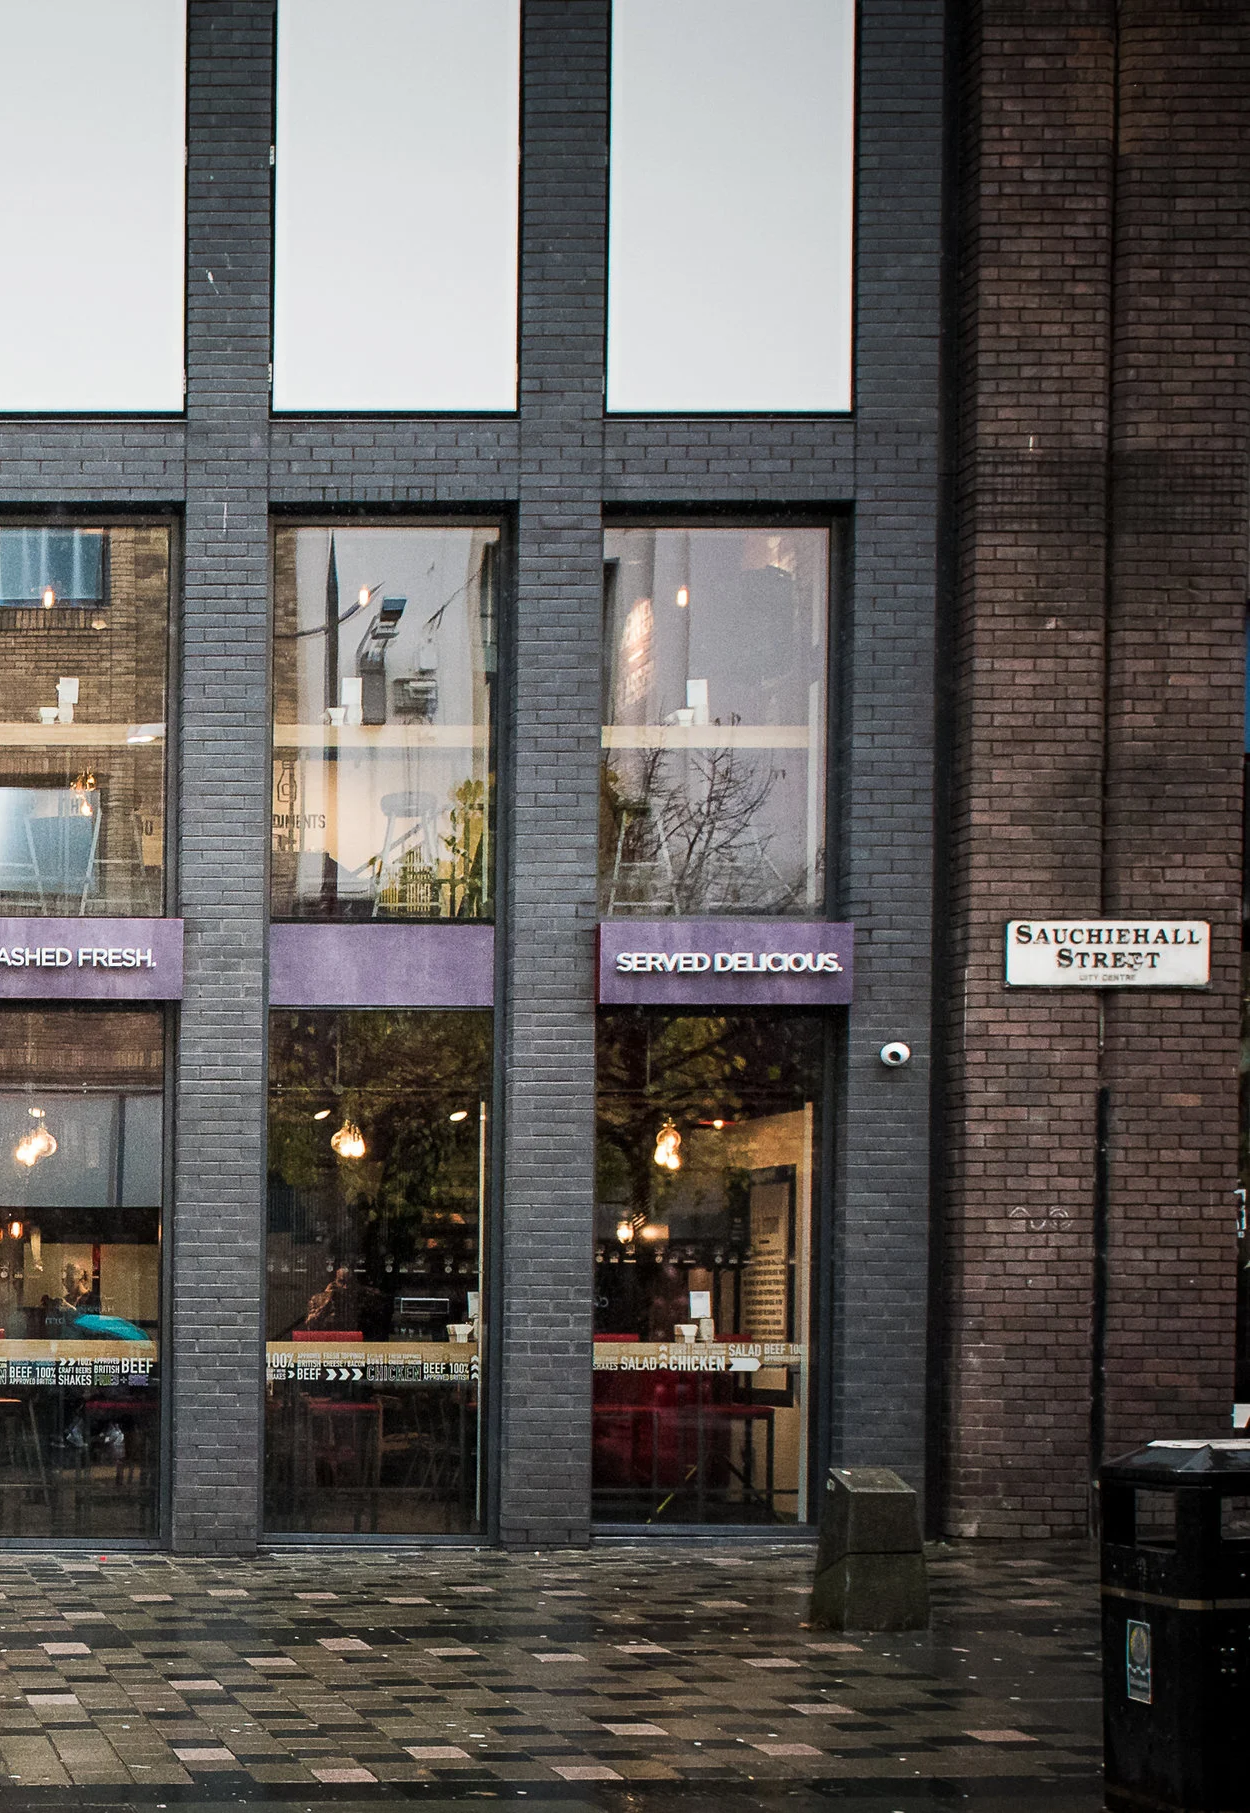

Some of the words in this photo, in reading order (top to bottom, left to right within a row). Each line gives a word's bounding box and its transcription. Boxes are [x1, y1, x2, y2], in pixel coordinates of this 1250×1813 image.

[1015, 924, 1202, 945] SAUCHIEHALL
[77, 947, 157, 968] FRESH.
[616, 952, 711, 972] SERVED
[714, 952, 843, 972] DELICIOUS.
[1102, 973, 1137, 982] CENTRE
[728, 1343, 762, 1357] SALAD
[764, 1343, 786, 1355] BEEF
[121, 1357, 154, 1374] BEEF
[266, 1352, 295, 1368] 100%
[620, 1355, 657, 1371] SALAD
[669, 1355, 726, 1372] CHICKEN
[9, 1366, 33, 1378] BEEF
[35, 1366, 56, 1378] 100%
[58, 1366, 75, 1374] CRAFT
[75, 1366, 92, 1374] BEERS
[93, 1365, 120, 1374] BRITISH
[297, 1368, 322, 1380] BEEF
[366, 1365, 422, 1381] CHICKEN
[423, 1362, 446, 1374] BEEF
[449, 1363, 470, 1374] 100%
[58, 1374, 92, 1386] SHAKES
